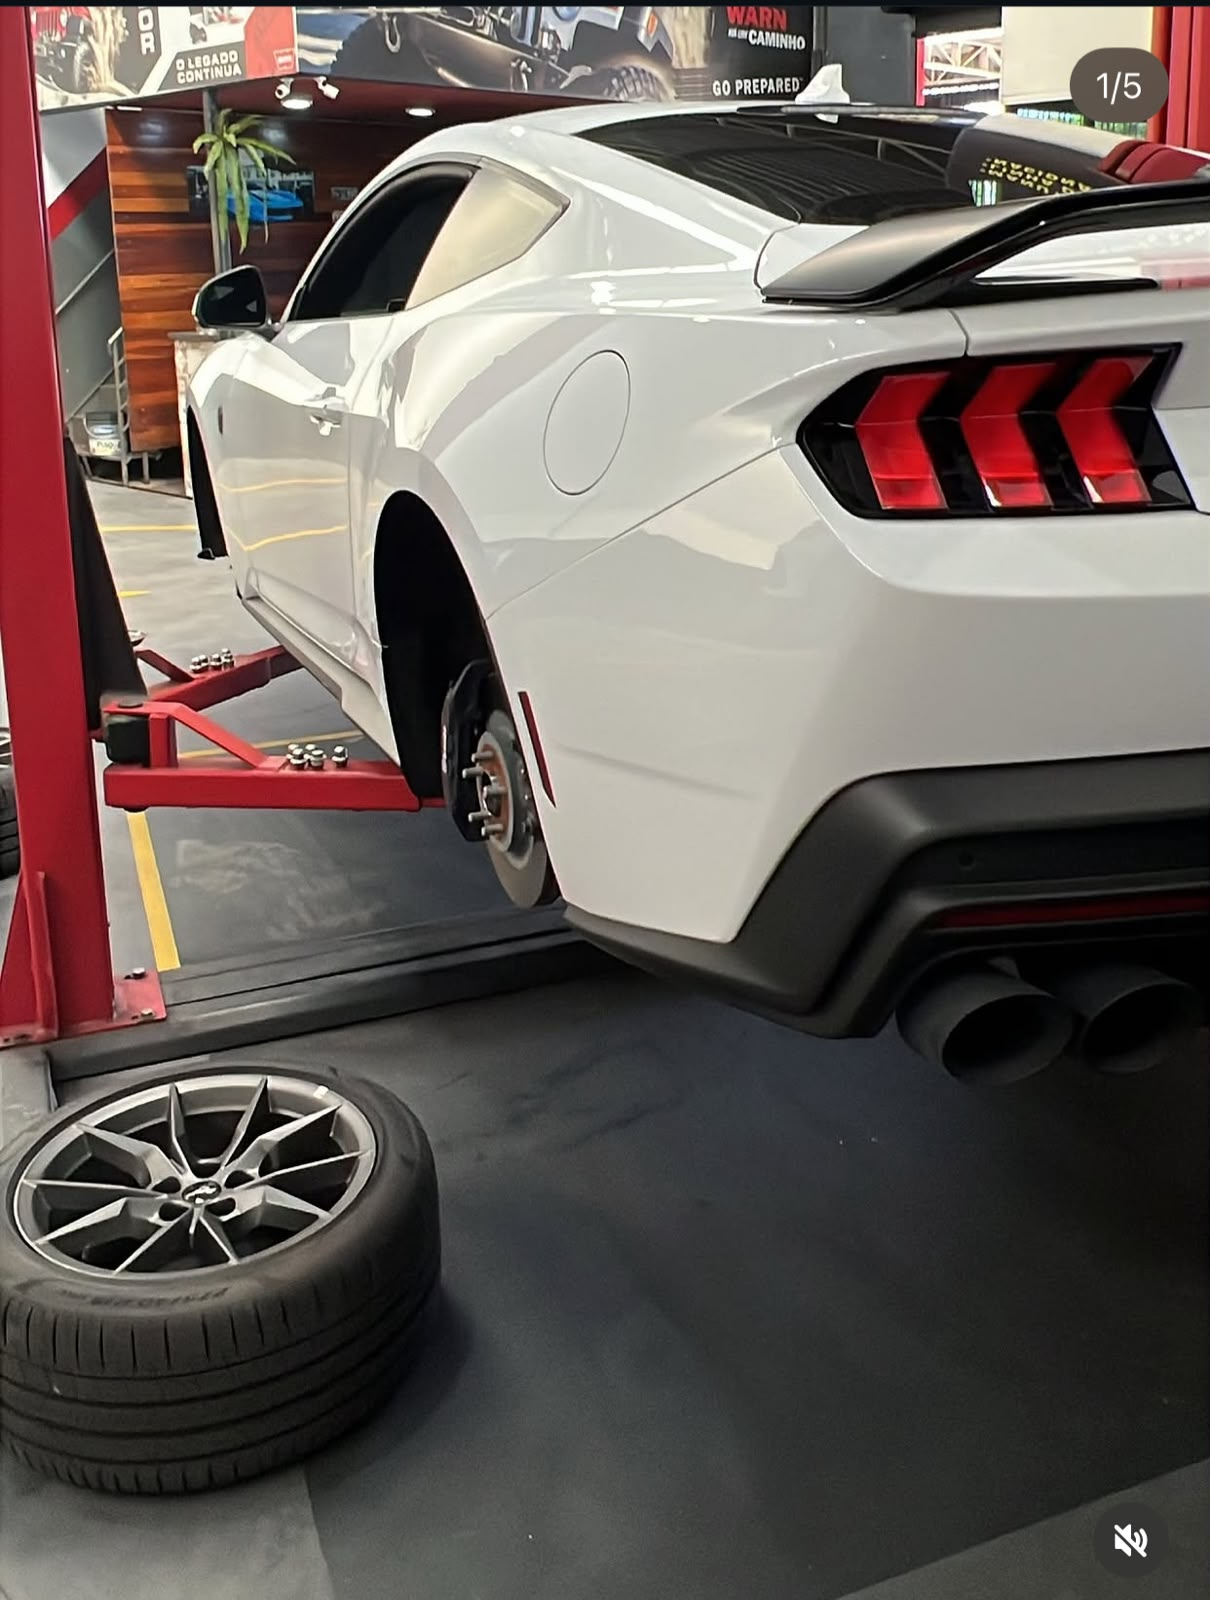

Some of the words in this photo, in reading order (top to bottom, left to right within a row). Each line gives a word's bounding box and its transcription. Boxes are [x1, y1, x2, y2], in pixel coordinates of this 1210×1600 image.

[726, 6, 787, 32] WARN
[137, 6, 155, 55] OR
[748, 29, 806, 50] CAMINHO
[187, 50, 239, 70] LEGADO
[177, 63, 242, 84] CONTINUA
[712, 79, 731, 97] GO
[735, 77, 800, 95] PREPARED
